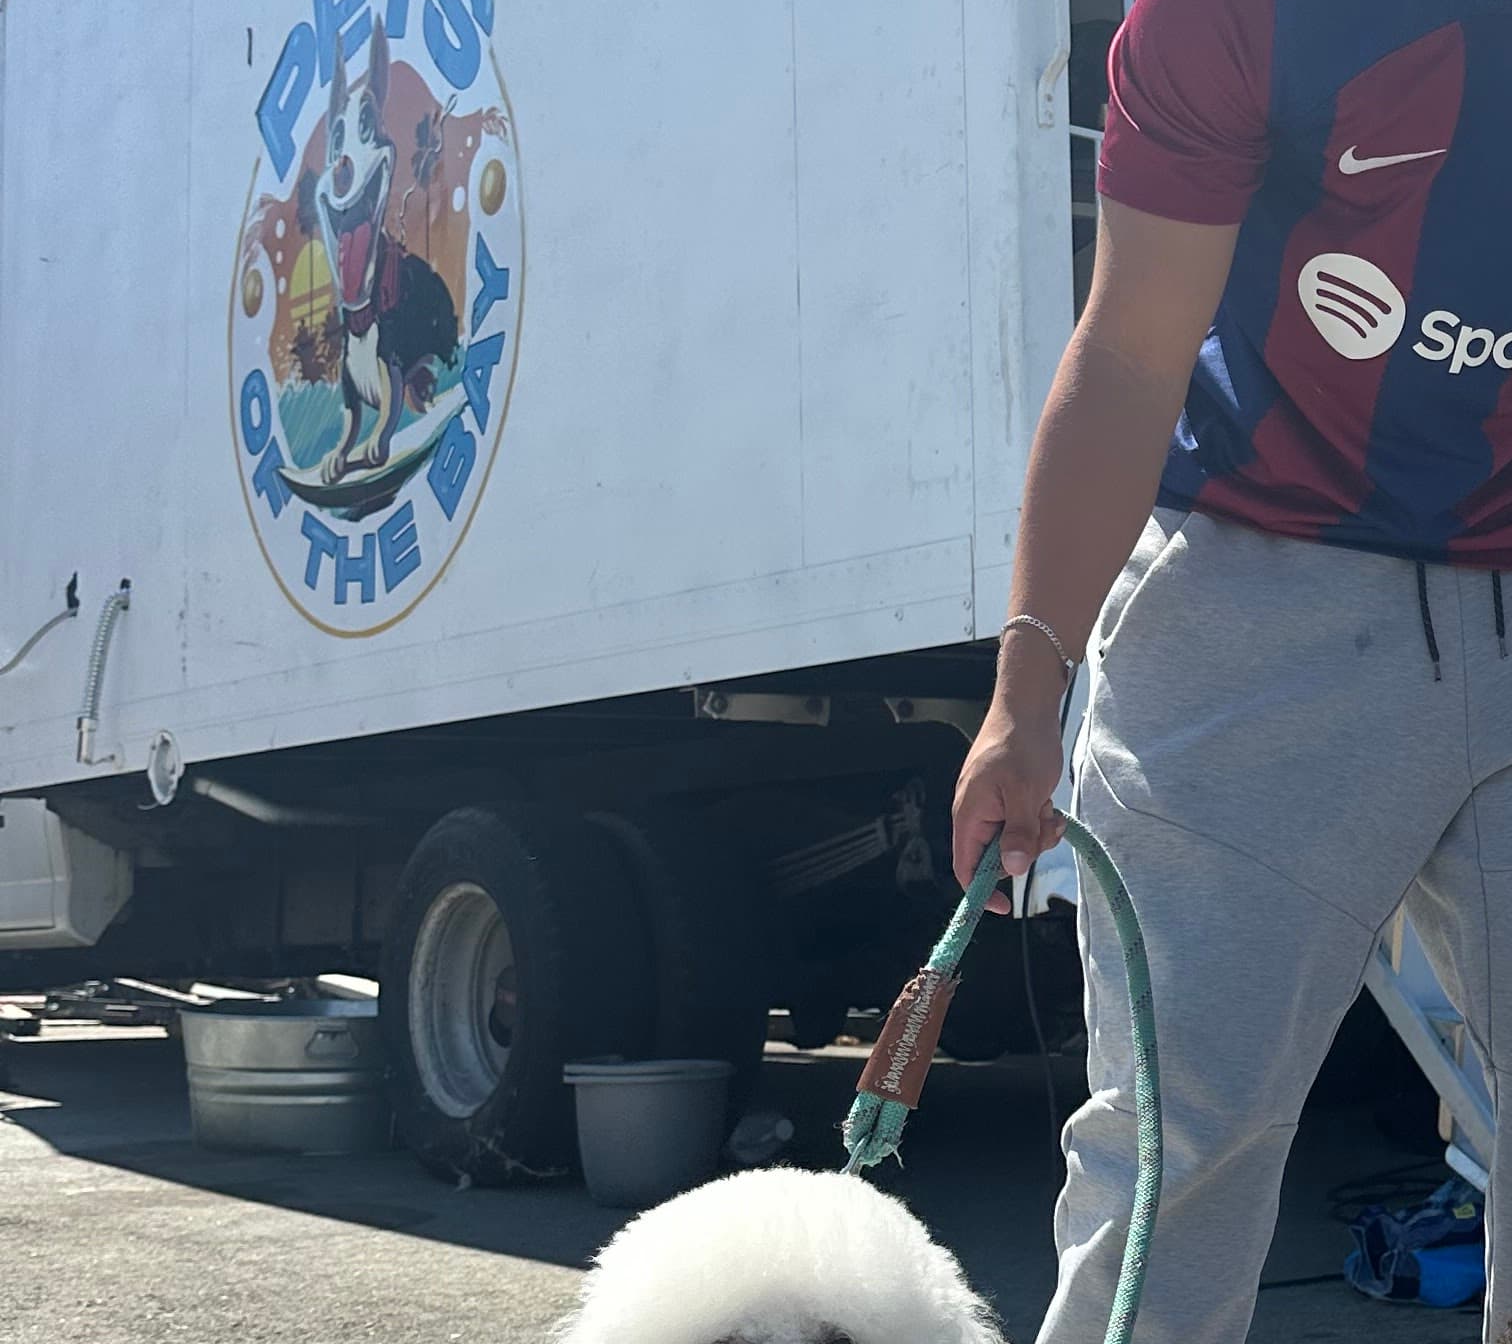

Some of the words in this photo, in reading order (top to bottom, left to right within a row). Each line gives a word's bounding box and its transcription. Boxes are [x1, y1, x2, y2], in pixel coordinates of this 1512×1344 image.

[240, 368, 294, 519] OF
[300, 499, 421, 605] THE
[427, 231, 510, 523] BAY
